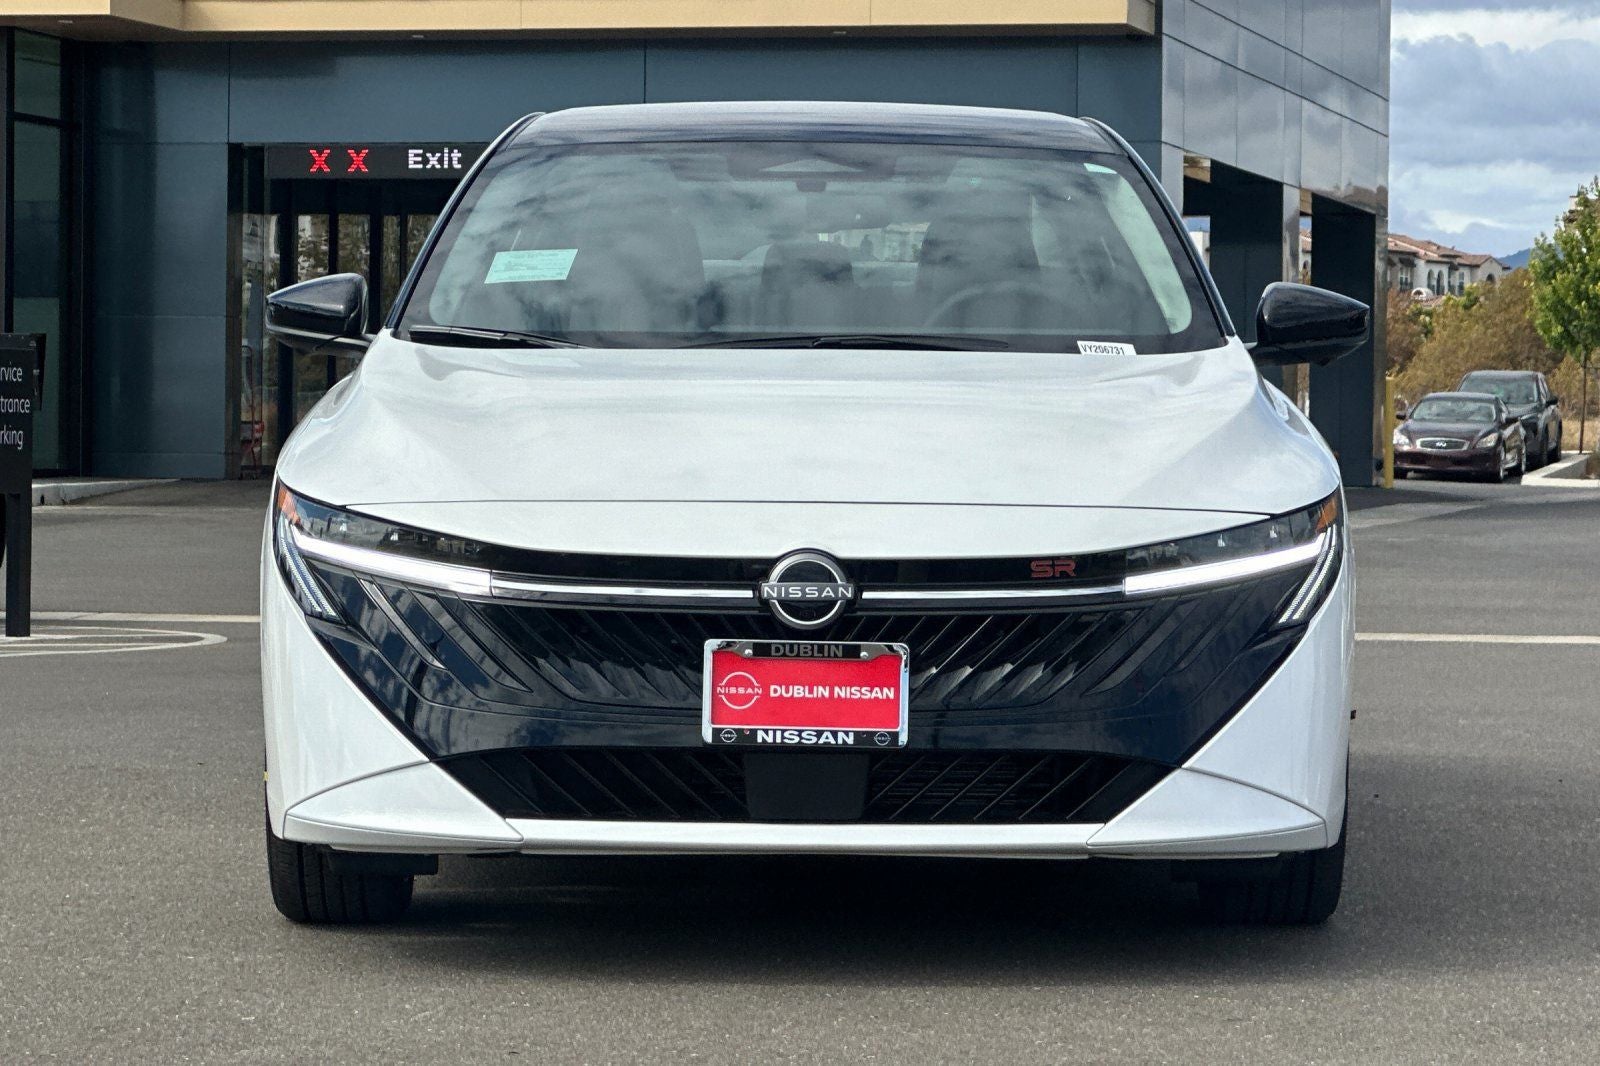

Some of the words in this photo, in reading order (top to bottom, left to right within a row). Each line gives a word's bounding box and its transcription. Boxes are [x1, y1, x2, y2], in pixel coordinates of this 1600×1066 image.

[408, 147, 462, 170] Exit
[1080, 344, 1125, 356] VY206731
[1030, 559, 1077, 578] SR
[763, 585, 852, 599] NISSAN
[770, 643, 843, 658] DUBLIN
[716, 686, 762, 695] NISSAN
[769, 685, 830, 698] DUBLIN
[833, 686, 895, 700] NISSAN
[756, 729, 854, 745] NISSAN
